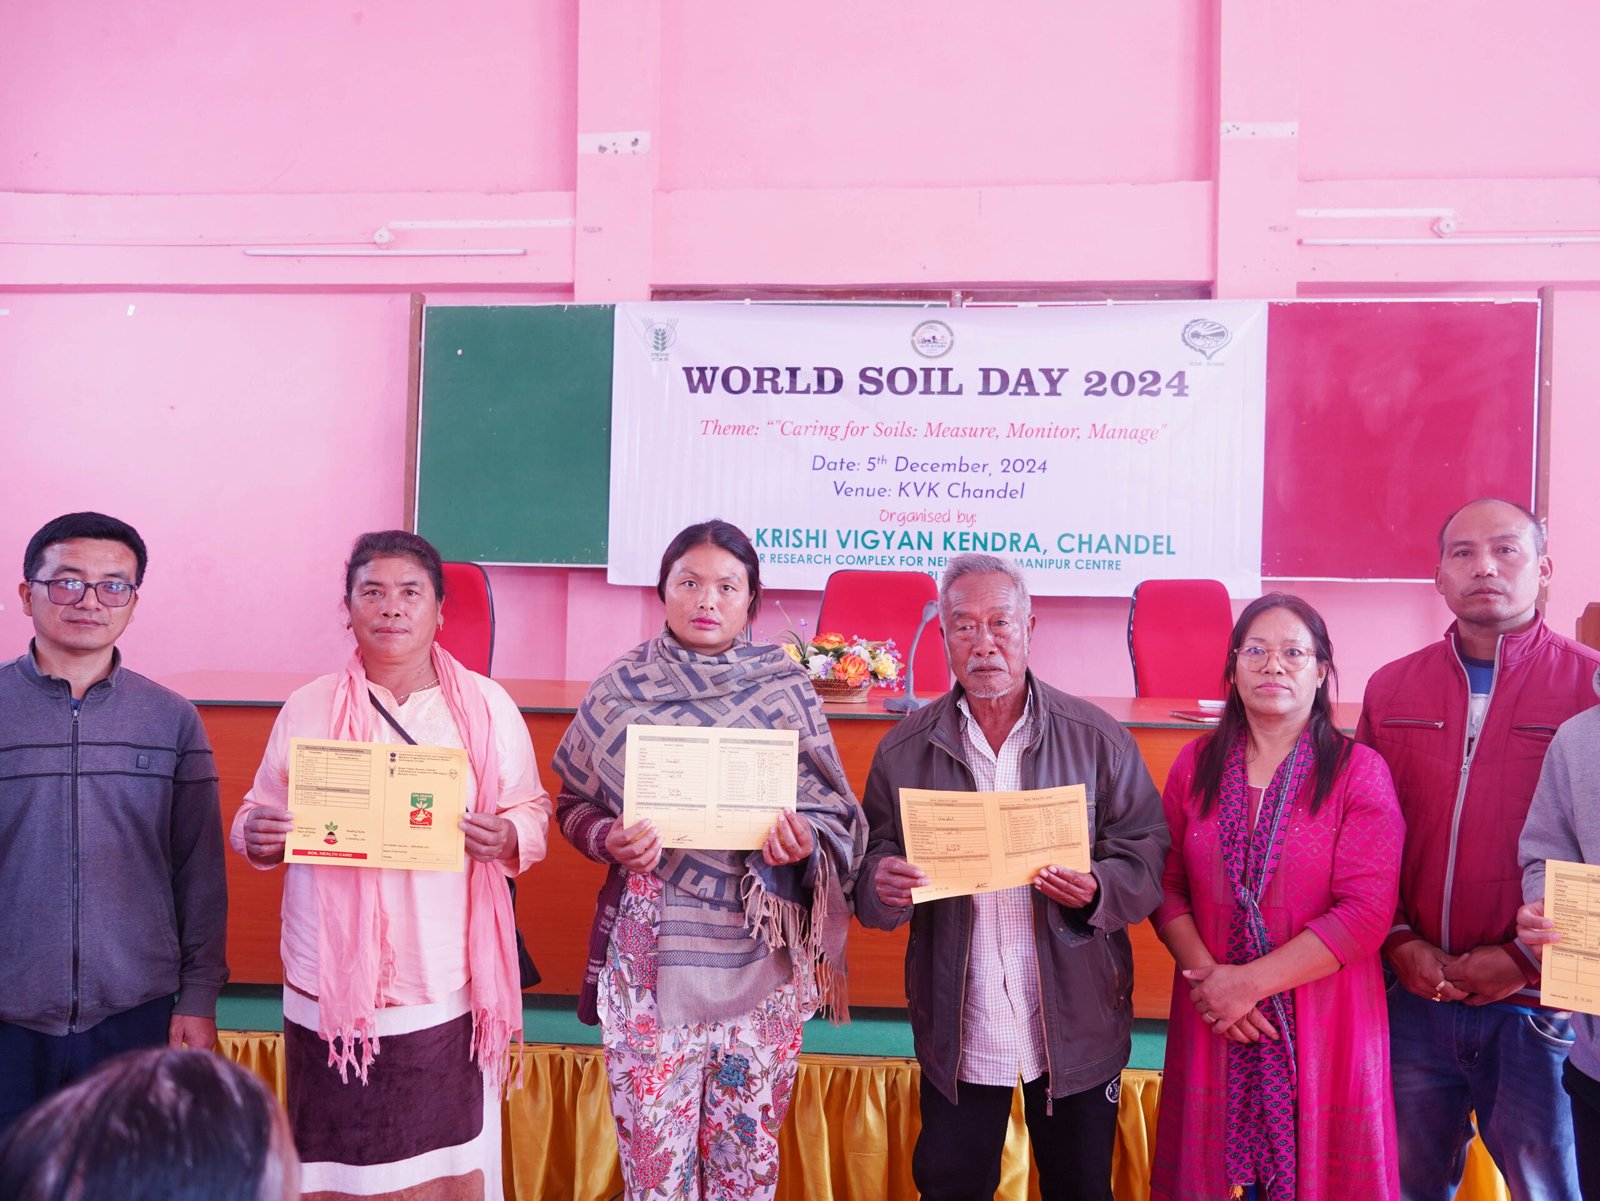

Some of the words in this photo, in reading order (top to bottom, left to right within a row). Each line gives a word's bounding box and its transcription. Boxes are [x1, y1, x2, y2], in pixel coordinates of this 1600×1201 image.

[682, 366, 843, 394] WORLD
[859, 367, 963, 396] SOIL
[978, 368, 1069, 396] DAY
[1084, 370, 1189, 397] 2024
[700, 419, 760, 436] Theme:
[840, 420, 869, 441] for
[873, 421, 918, 438] Soils:
[923, 422, 1000, 441] Measure,
[1006, 422, 1081, 441] Monitor,
[812, 455, 861, 472] Date:
[866, 454, 887, 472] 5th
[895, 456, 992, 477] December,
[1000, 458, 1048, 474] 2024
[833, 480, 892, 497] Venue:
[898, 481, 941, 498] KVK
[947, 482, 1026, 499] Chandel
[879, 508, 951, 527] Organised
[957, 509, 977, 528] by:
[836, 529, 933, 551] VIGYAN
[943, 531, 1047, 555] KENDRA,
[1057, 532, 1176, 555] CHANDEL
[770, 553, 831, 565] RESEARCH
[836, 554, 895, 566] COMPLEX
[899, 555, 923, 567] FOR
[1075, 559, 1121, 571] CENTRE
